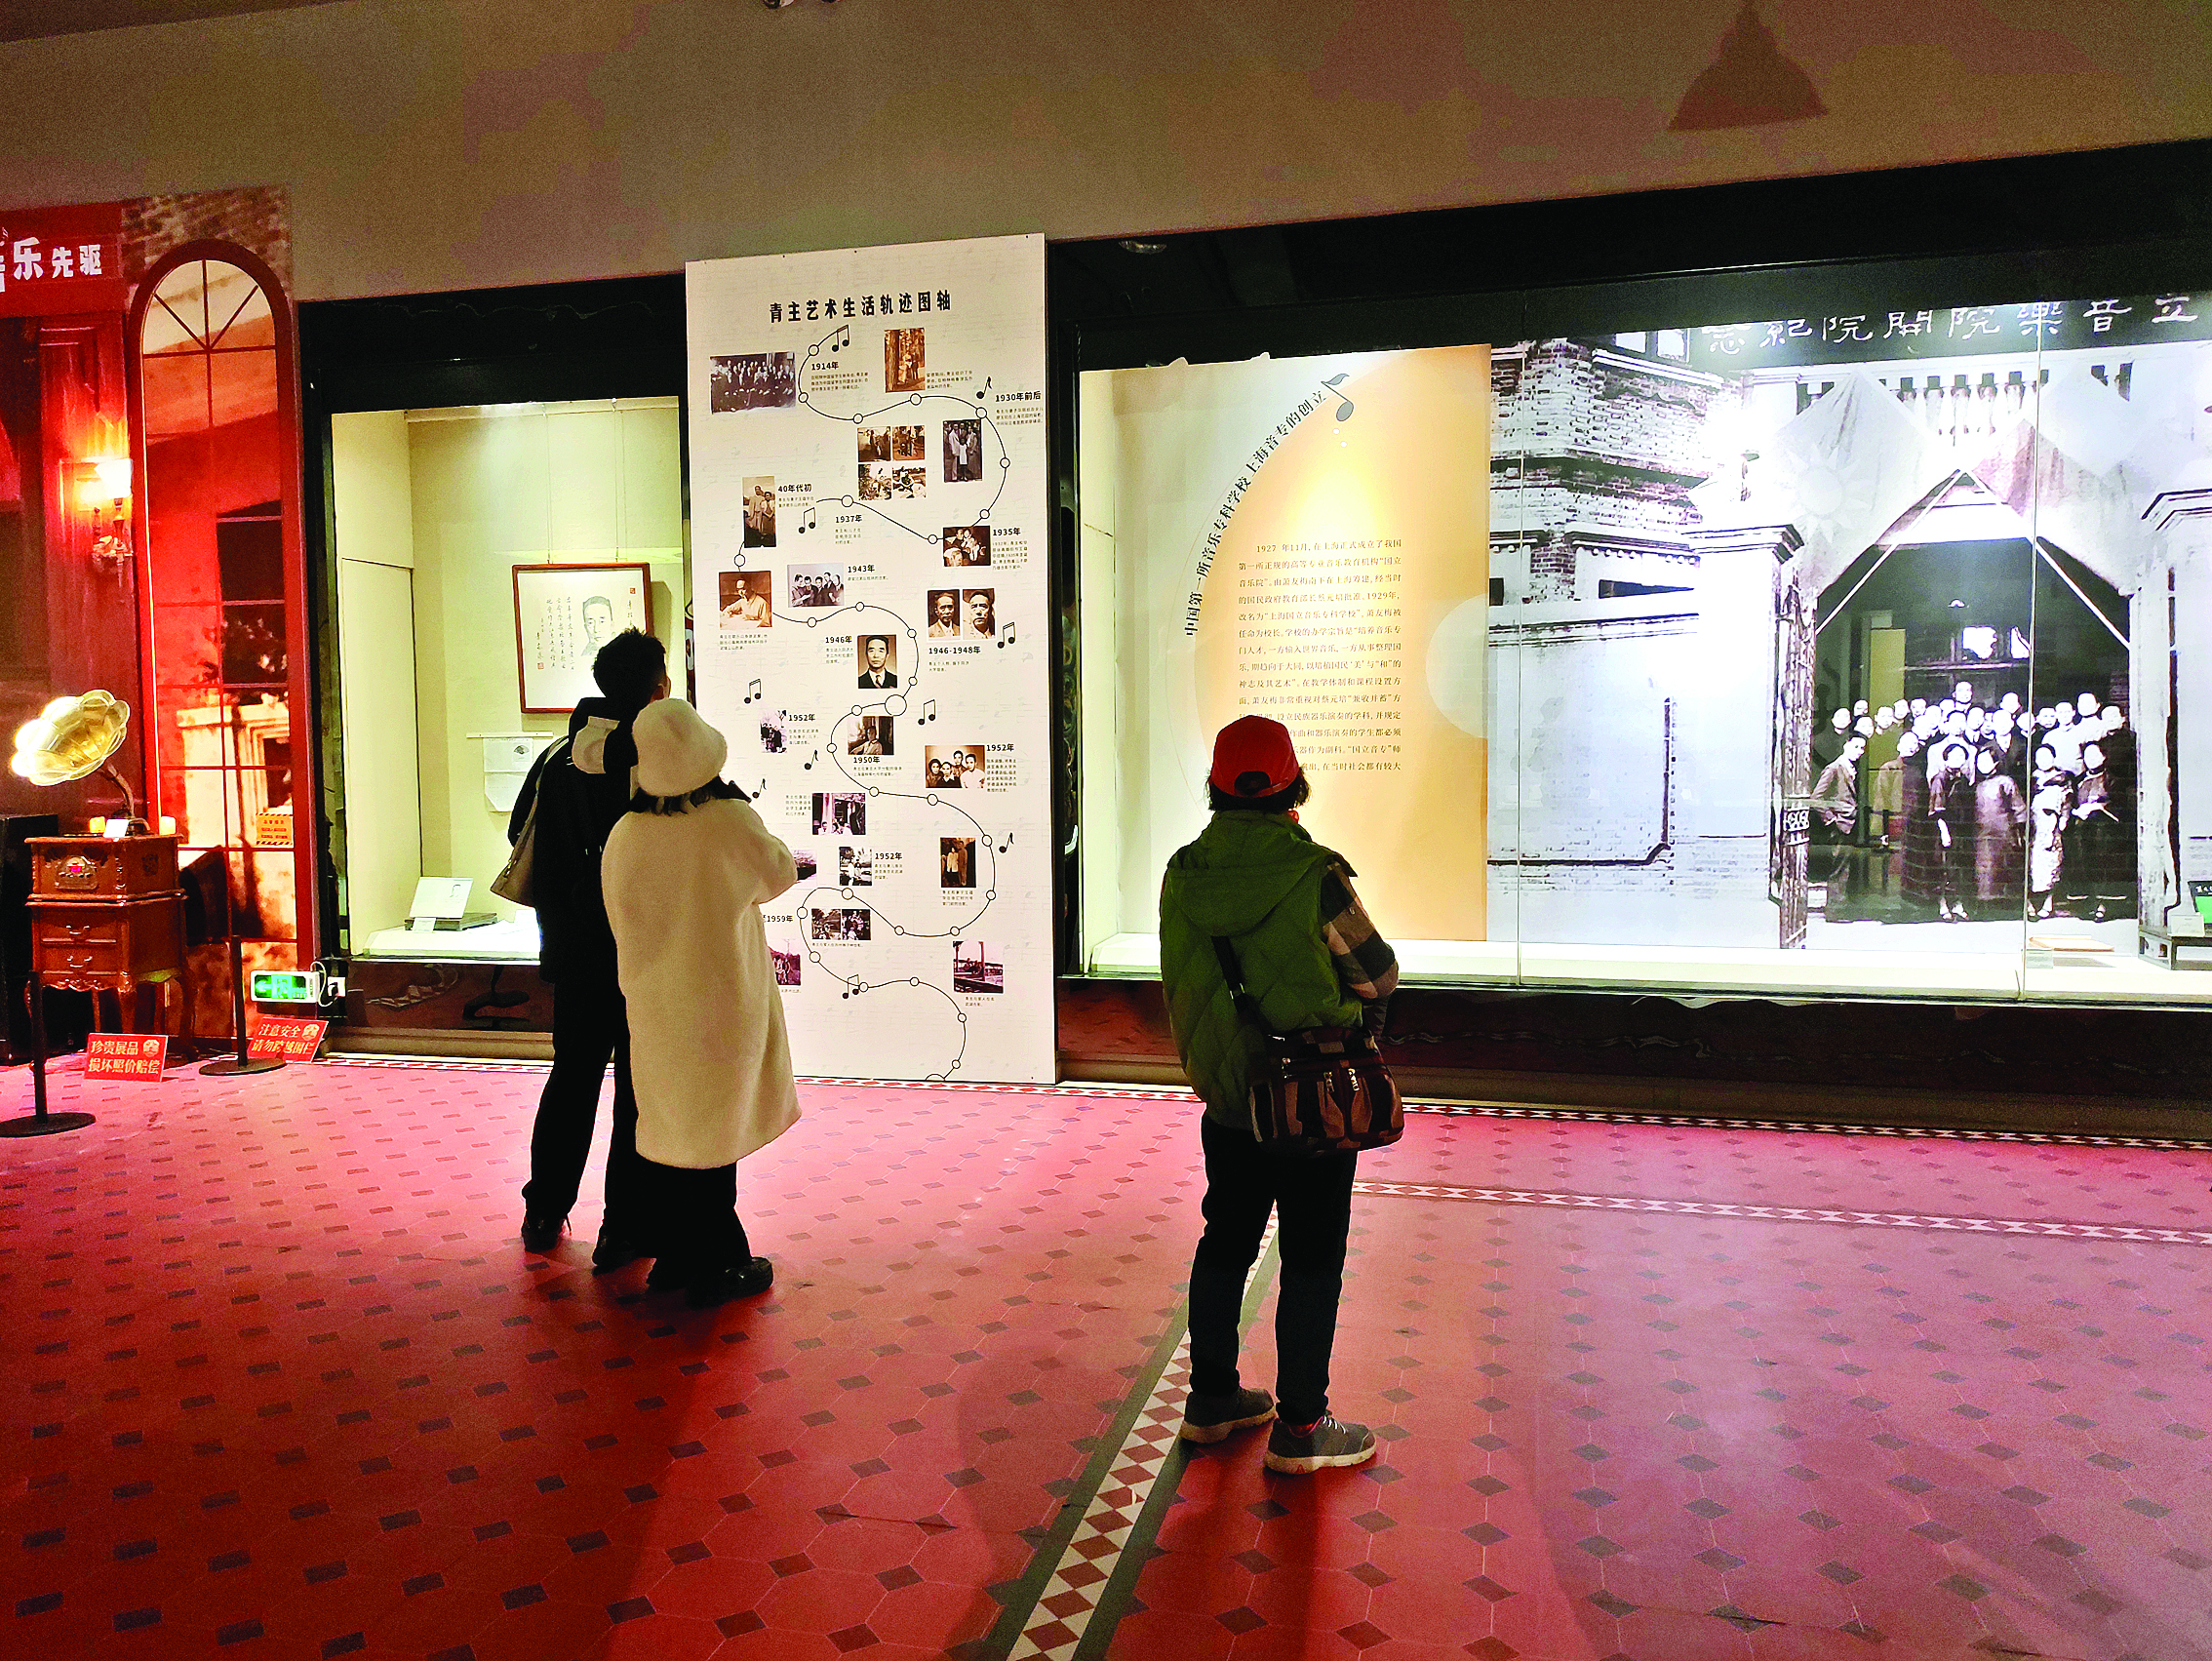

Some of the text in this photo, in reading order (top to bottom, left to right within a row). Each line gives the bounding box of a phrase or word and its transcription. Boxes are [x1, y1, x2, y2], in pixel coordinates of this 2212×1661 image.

[0, 237, 102, 292] 乐先驱
[769, 289, 951, 323] 青主艺术生活轨迹图轴
[811, 361, 839, 371] 1914年
[995, 390, 1042, 403] 1930年前后
[777, 483, 811, 493] 40年代初
[835, 514, 862, 524] 1937年
[992, 527, 1021, 536] 1935年
[1256, 544, 1277, 553] 1927
[848, 564, 875, 573] 1943年
[825, 635, 852, 645] 1946年
[928, 646, 981, 655] 1946-1948年
[788, 713, 815, 722] 1952年
[986, 743, 1014, 753] 1952年
[852, 755, 881, 765] 1950年
[875, 851, 903, 861] 1952年
[763, 914, 794, 923] 1959年
[257, 1023, 301, 1038] 注意安全
[91, 1040, 138, 1055] 珍贵展品
[88, 1058, 161, 1074] 损坏照价赔偿
